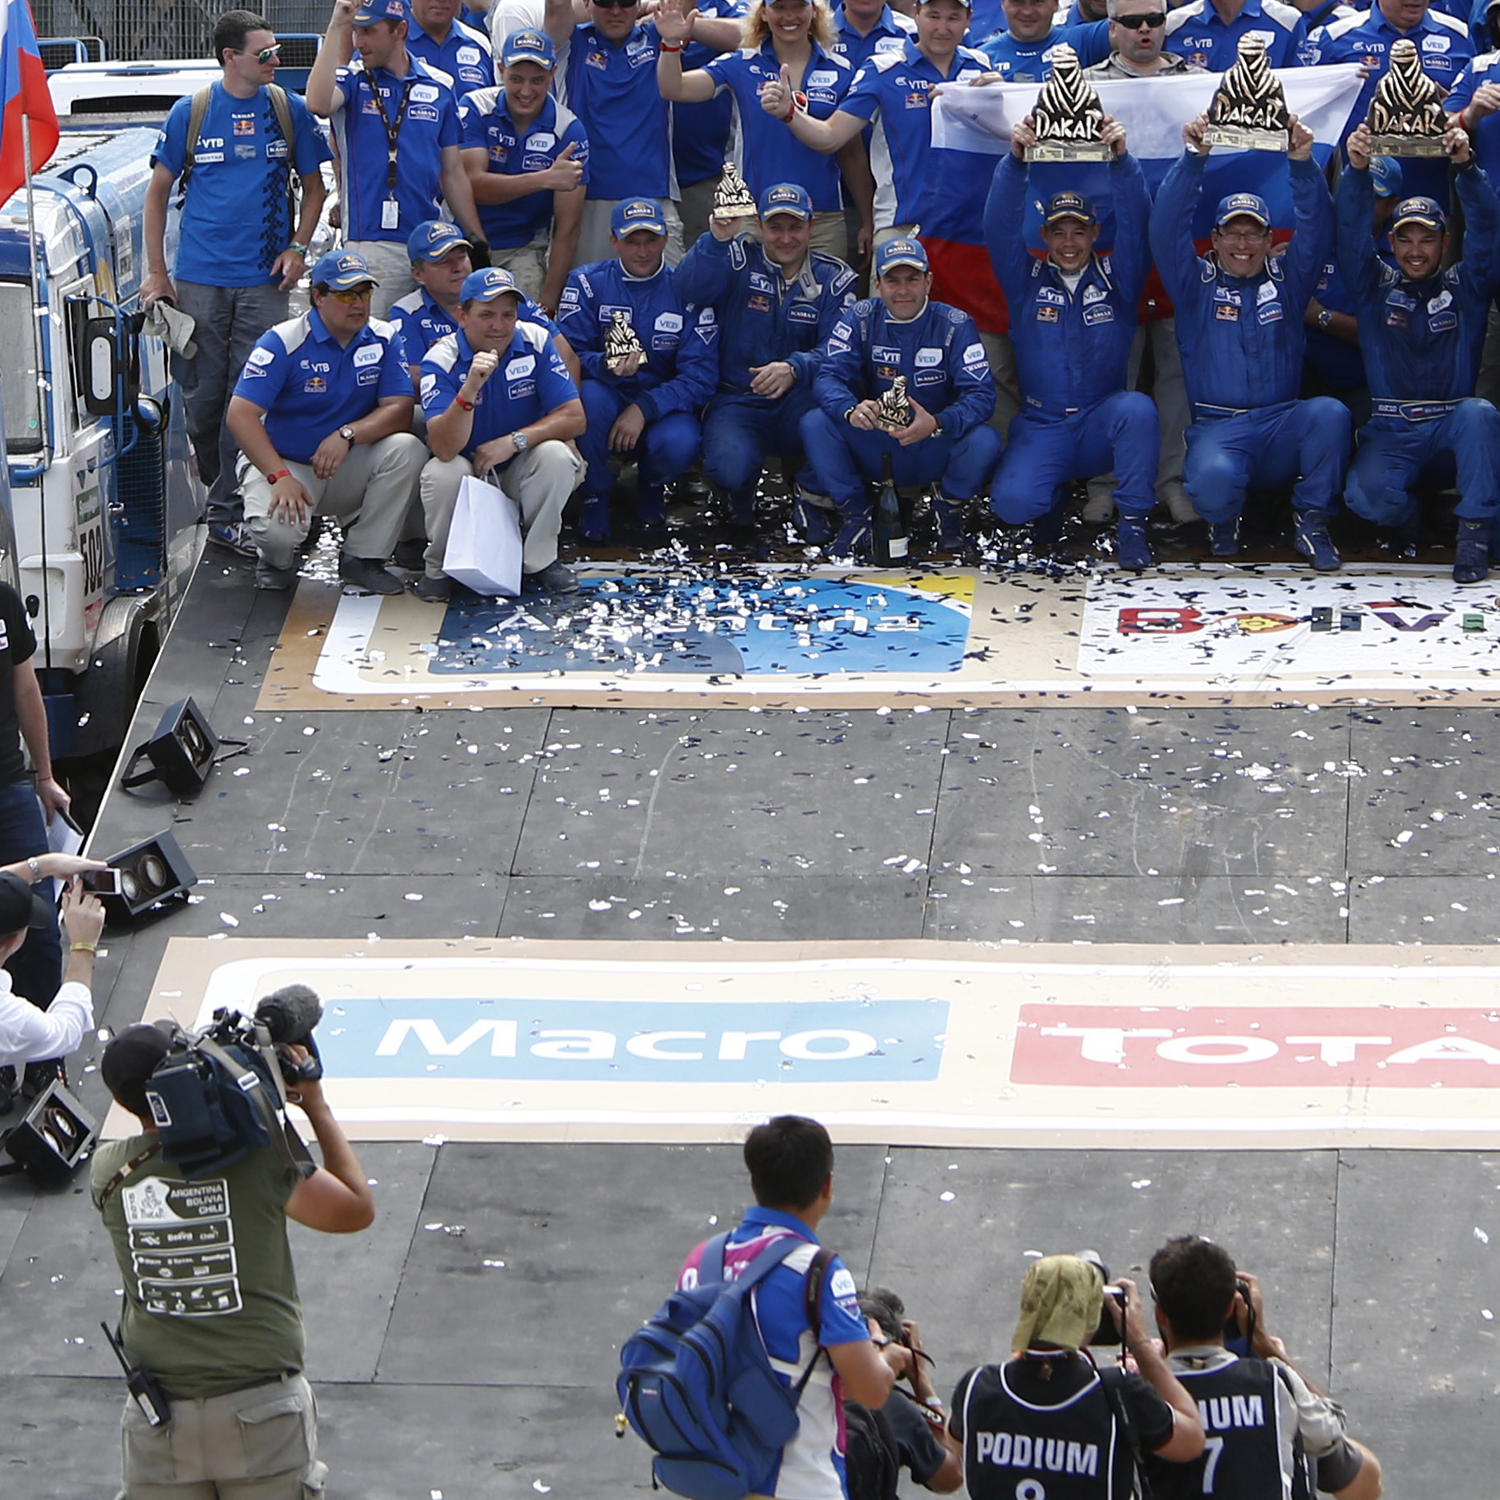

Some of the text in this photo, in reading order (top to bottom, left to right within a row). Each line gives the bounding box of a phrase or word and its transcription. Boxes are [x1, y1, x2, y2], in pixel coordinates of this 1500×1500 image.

[1195, 38, 1212, 48] VTB
[1364, 43, 1385, 52] VTB
[1426, 40, 1446, 49] VEB
[459, 51, 477, 61] VEB
[810, 76, 832, 84] VEB
[909, 80, 928, 90] VTB
[412, 89, 433, 99] VEB
[1217, 99, 1284, 129] DAKAR
[1373, 101, 1445, 134] DAKAR
[1036, 109, 1102, 140] DAKAR
[202, 138, 224, 148] VTB
[529, 138, 549, 148] VEB
[1047, 292, 1065, 304] VTB
[433, 323, 452, 334] VTB
[659, 320, 679, 330] VEB
[357, 352, 377, 363] VEB
[311, 362, 331, 373] VTB
[508, 364, 530, 377] VEB
[374, 1017, 879, 1062] Macro
[171, 1185, 222, 1198] ARGENTINA
[186, 1195, 223, 1206] BOLIVIA
[199, 1204, 224, 1215] CHILE
[976, 1431, 1099, 1479] PODIUM
